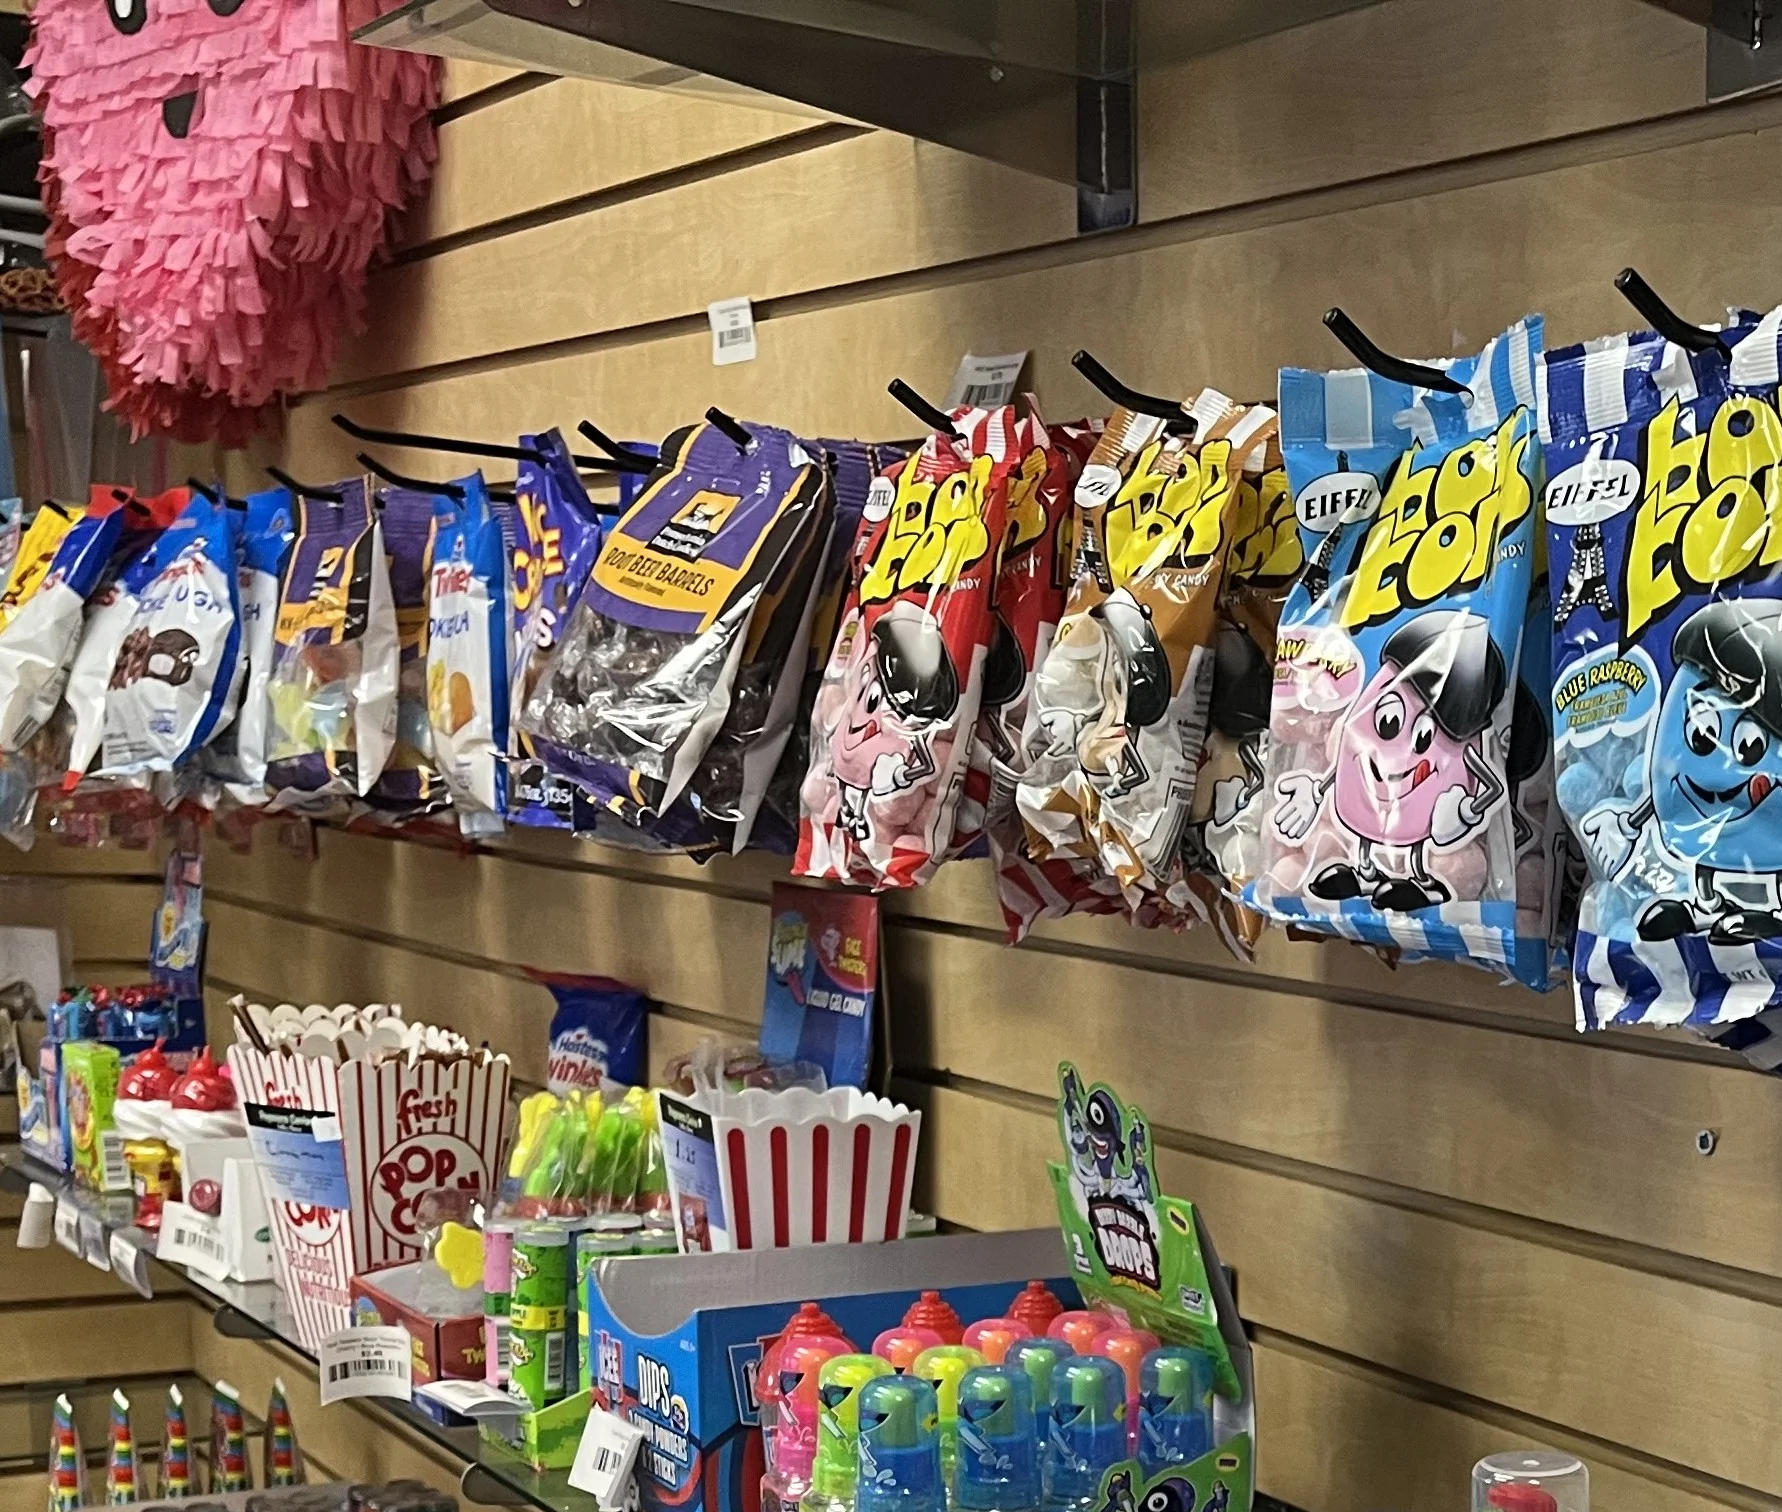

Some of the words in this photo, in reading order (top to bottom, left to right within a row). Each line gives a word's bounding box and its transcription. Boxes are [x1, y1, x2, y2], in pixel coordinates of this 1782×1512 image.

[655, 562, 715, 598] BARRELS
[1555, 674, 1587, 711] BLUE
[1590, 660, 1646, 694] RASPBERRY
[396, 1087, 459, 1136] fresh
[380, 1145, 457, 1196] POP
[1096, 1227, 1156, 1281] DROPS
[637, 1354, 671, 1419] DIPS
